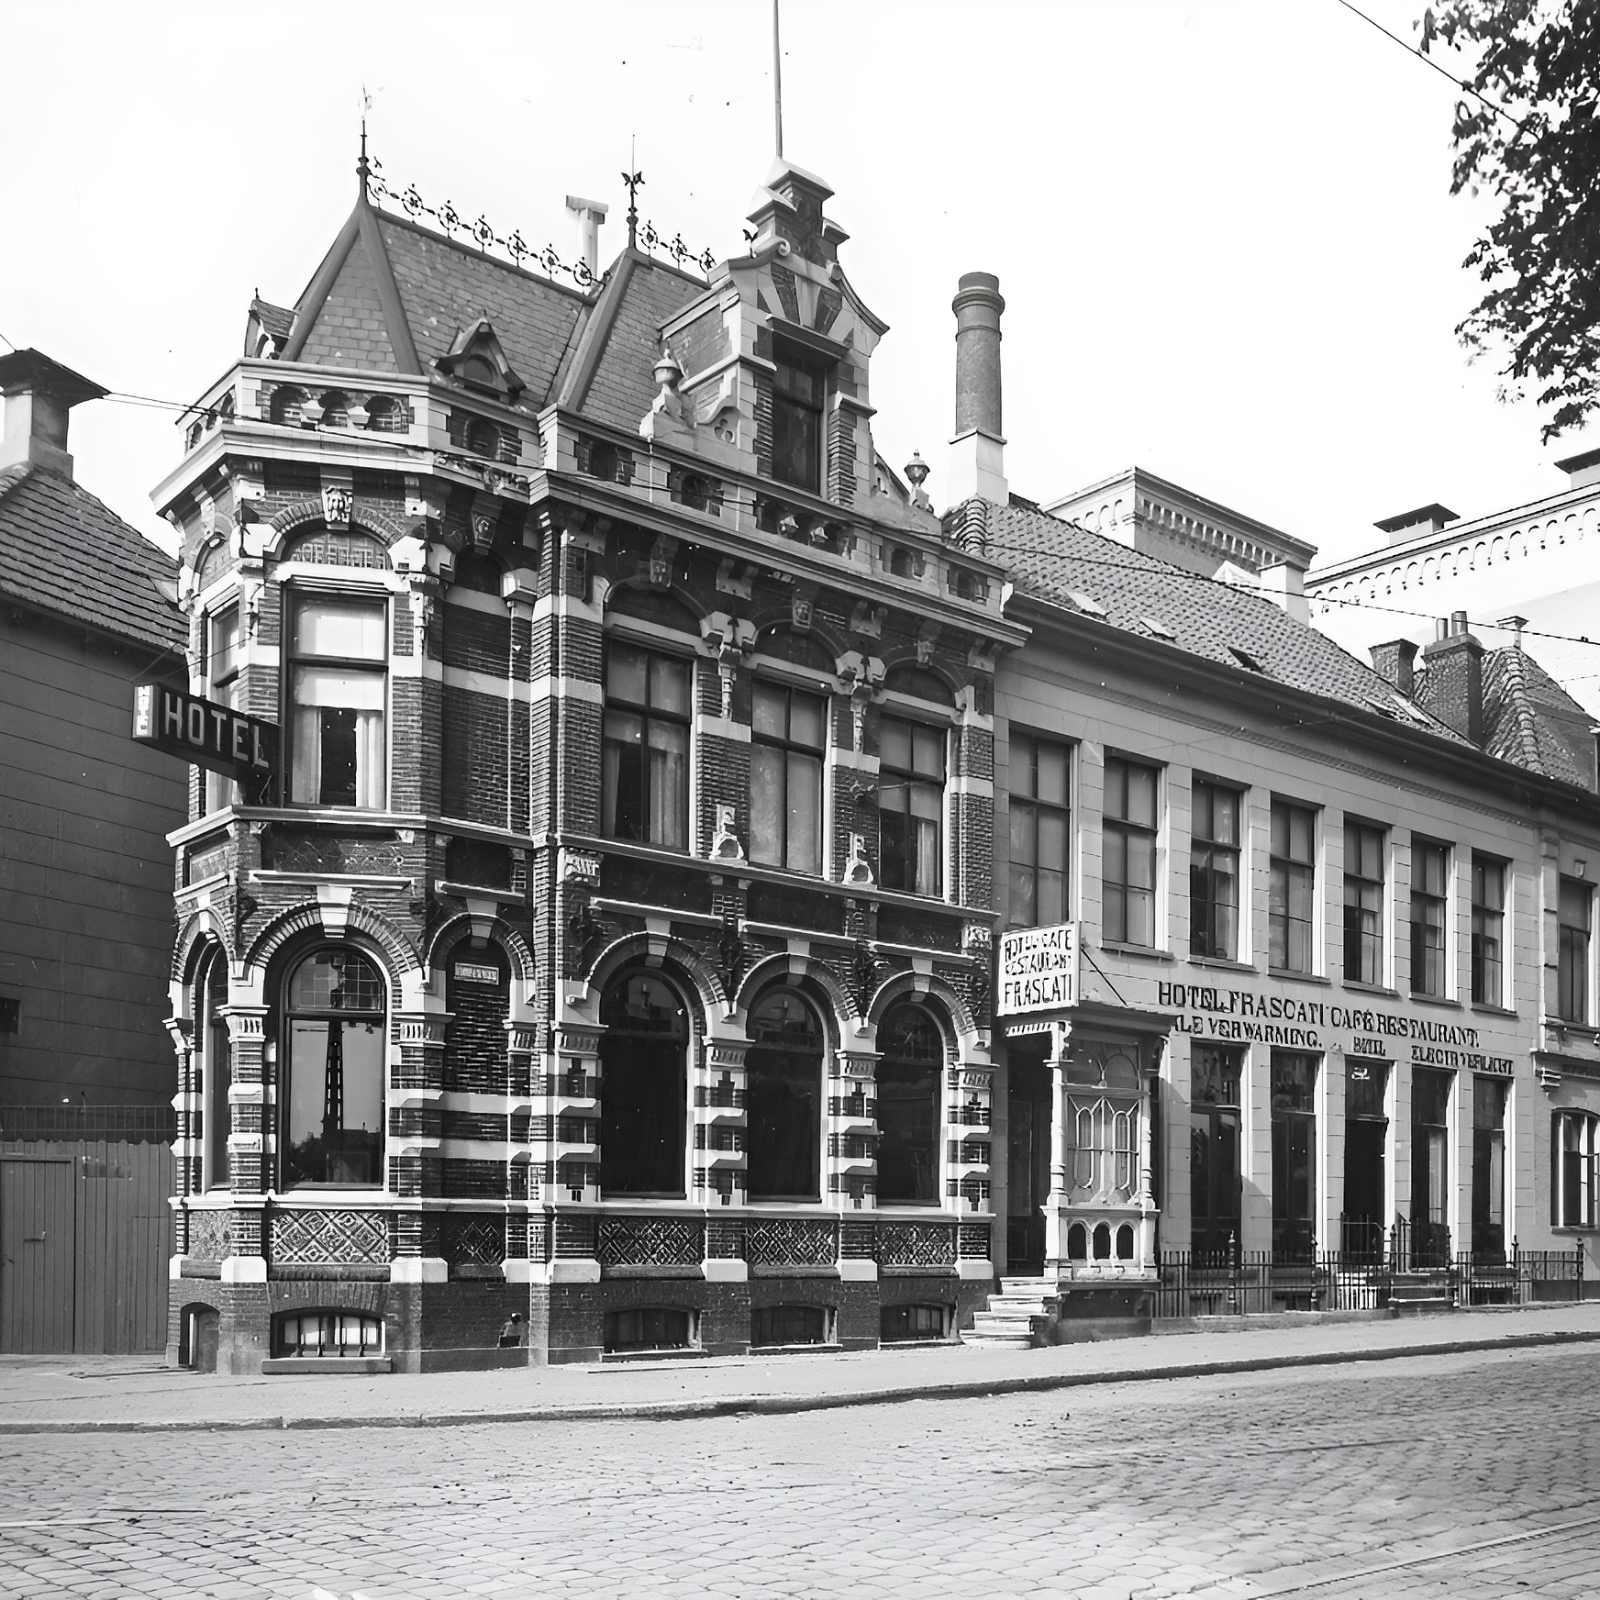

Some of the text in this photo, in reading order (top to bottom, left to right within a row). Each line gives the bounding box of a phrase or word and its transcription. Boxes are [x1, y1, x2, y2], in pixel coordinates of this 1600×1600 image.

[164, 691, 270, 769] HOTEL
[1004, 974, 1072, 1008] FRASCATI
[1158, 980, 1228, 1013] HOTEL
[1228, 990, 1326, 1028] FRASCATI
